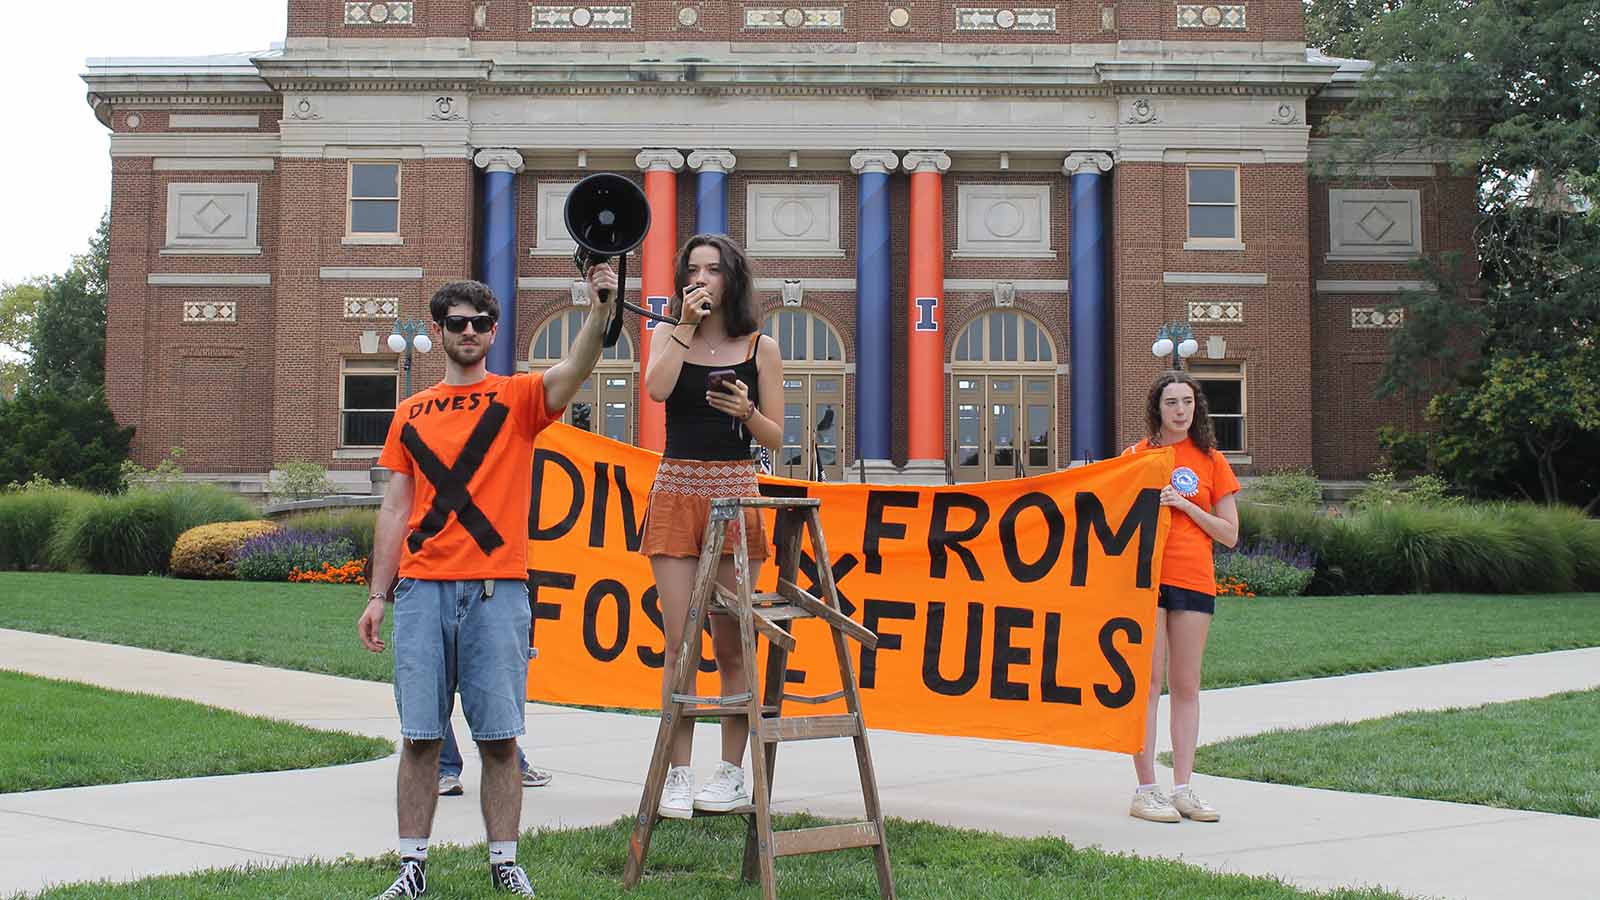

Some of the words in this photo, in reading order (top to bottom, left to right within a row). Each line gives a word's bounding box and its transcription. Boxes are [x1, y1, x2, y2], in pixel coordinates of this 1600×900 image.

[915, 297, 938, 331] I
[409, 391, 498, 420] DIVEST
[862, 488, 1162, 589] FROM
[859, 598, 1143, 709] FUELS
